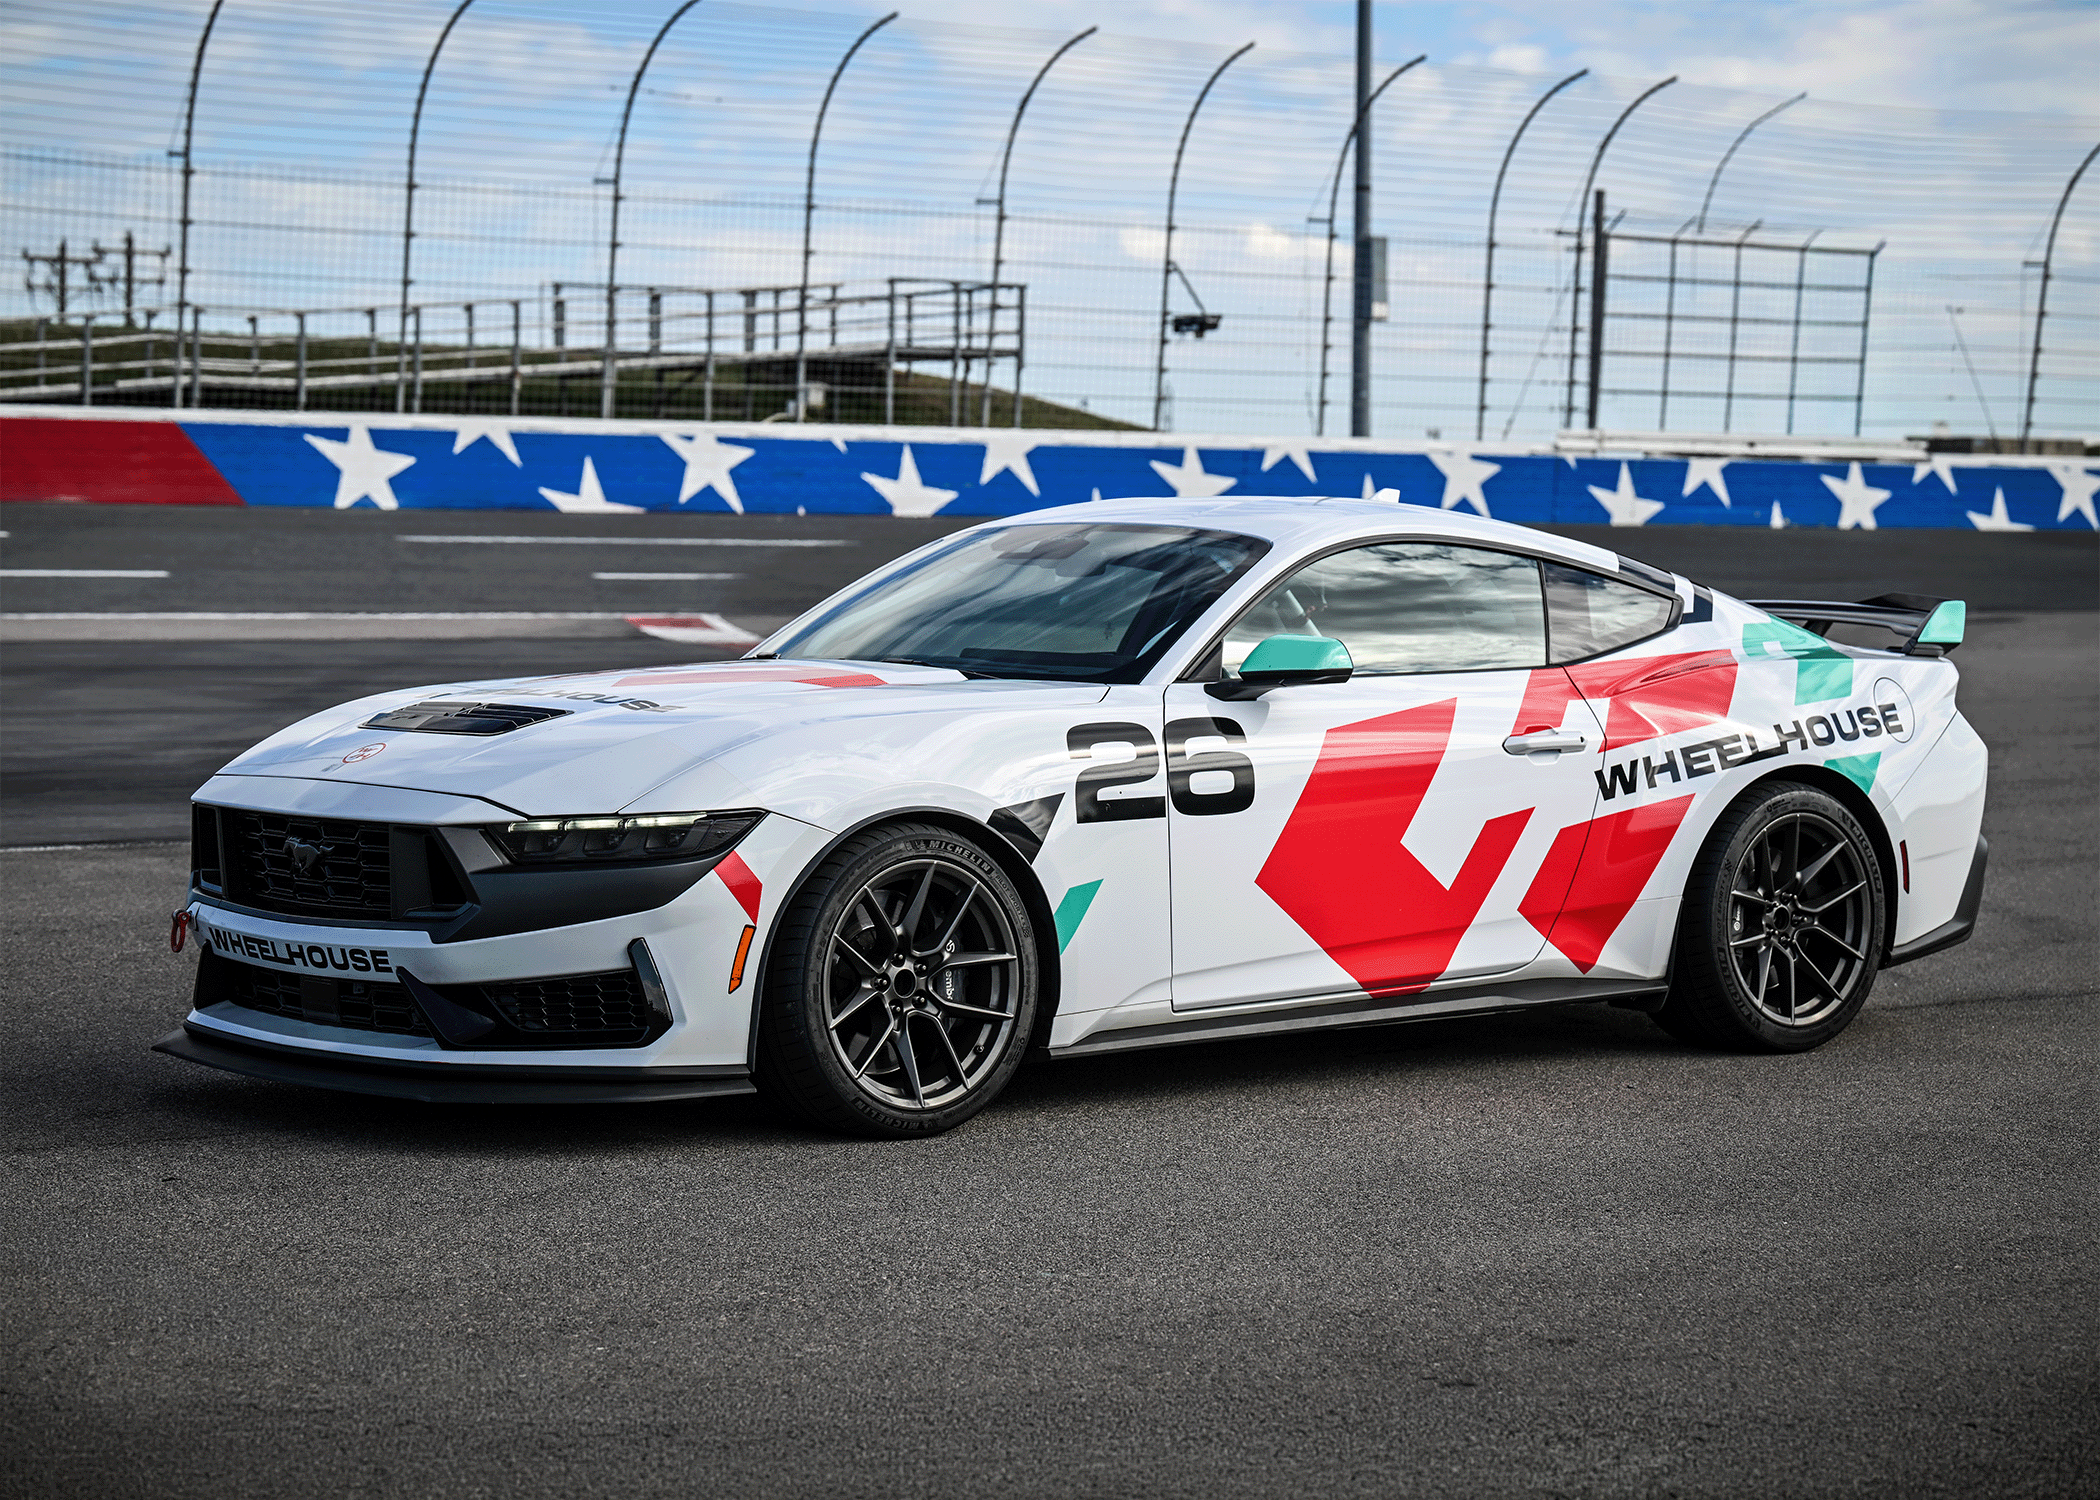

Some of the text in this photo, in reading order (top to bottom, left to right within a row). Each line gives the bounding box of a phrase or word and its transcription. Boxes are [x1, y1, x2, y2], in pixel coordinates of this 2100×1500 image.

[1066, 717, 1255, 824] 26
[1594, 703, 1904, 802] WHEELHOUSE
[928, 840, 992, 872] MICHELIN
[208, 926, 394, 974] WHEELHOUSE
